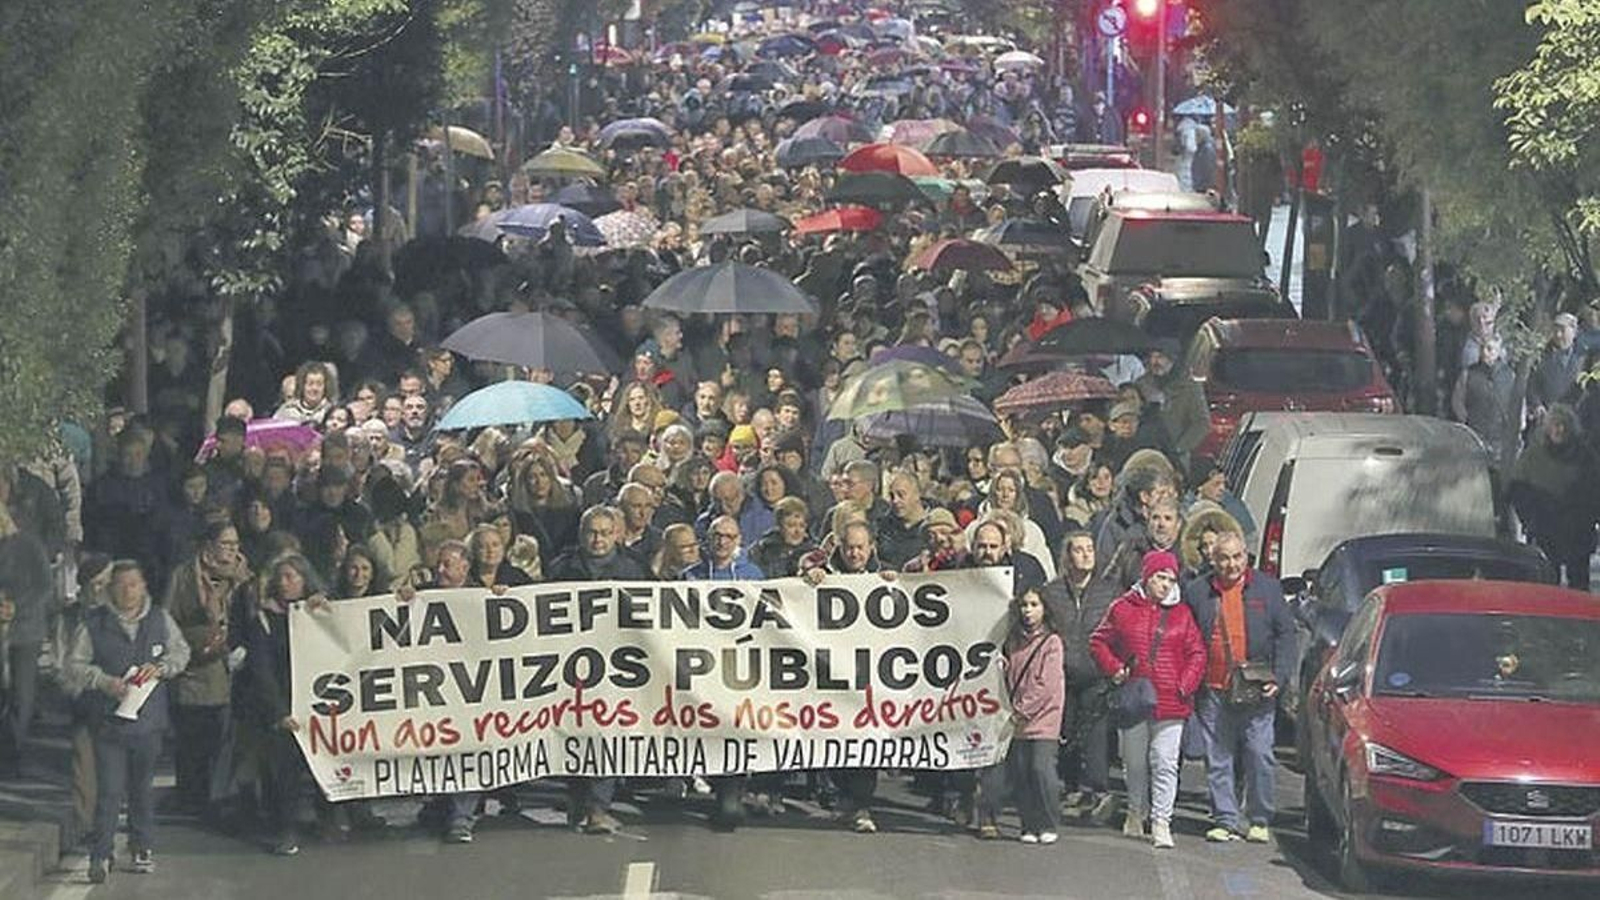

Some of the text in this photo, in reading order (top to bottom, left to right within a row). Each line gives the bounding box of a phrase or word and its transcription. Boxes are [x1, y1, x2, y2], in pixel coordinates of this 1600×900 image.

[369, 584, 950, 650] NA DEFENSA DOS
[312, 634, 997, 716] SERVIZOS PÚBLICOS
[309, 677, 999, 756] Non aos recortes dos nosos dereitos
[375, 738, 550, 795] PLATAFORMA
[565, 735, 706, 775] SANITARIA
[723, 738, 757, 773] DE
[773, 732, 949, 771] VALDEFORRAS
[1500, 826, 1542, 845] 1071
